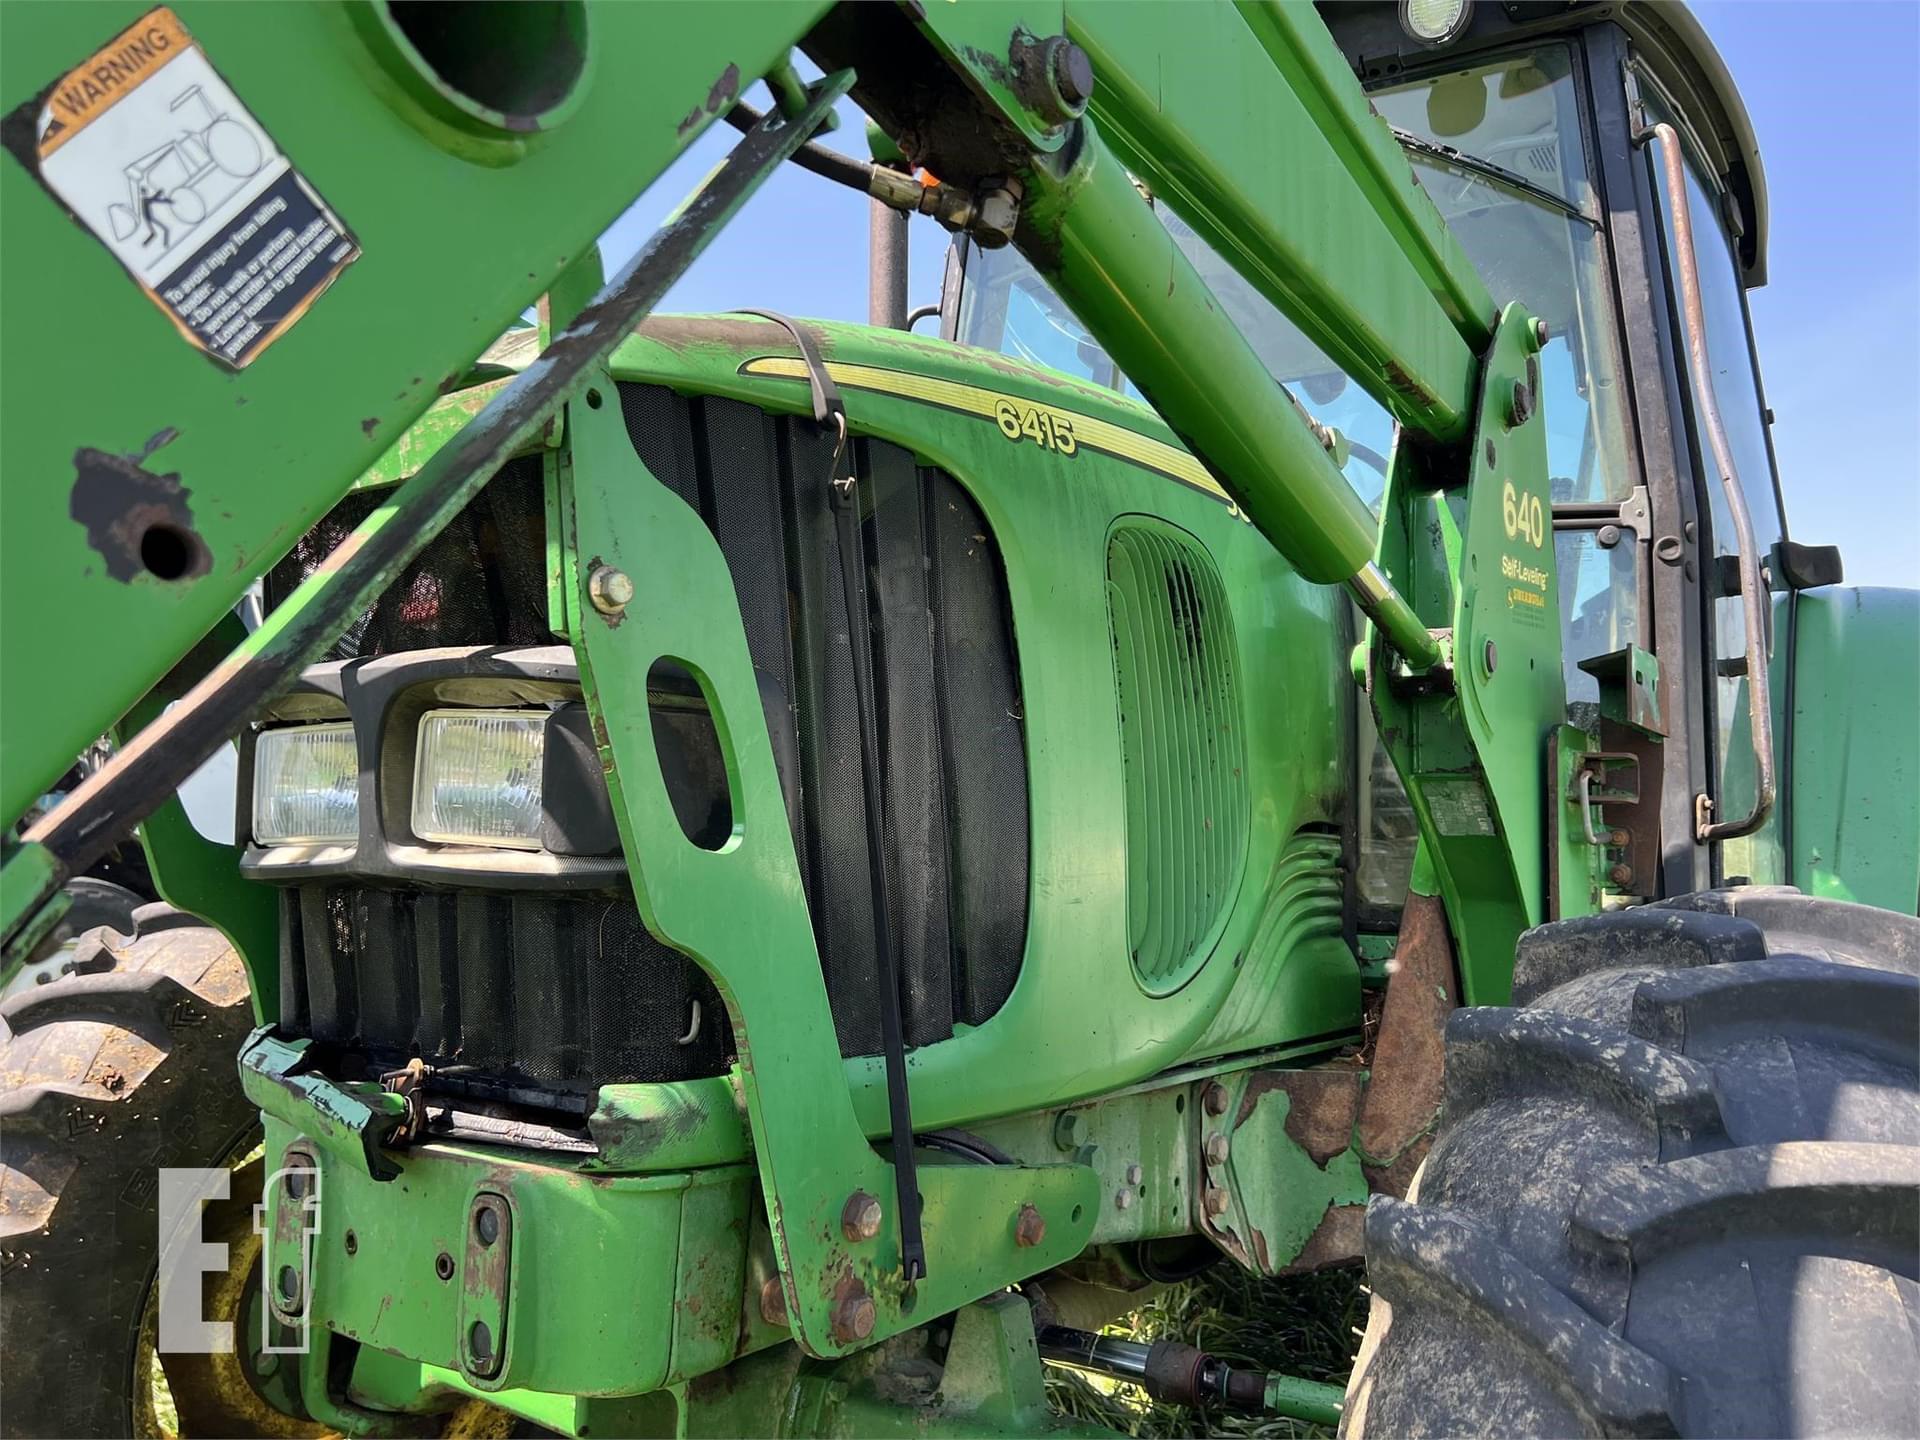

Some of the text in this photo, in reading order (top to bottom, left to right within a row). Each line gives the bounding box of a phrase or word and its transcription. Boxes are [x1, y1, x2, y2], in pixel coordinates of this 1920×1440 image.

[57, 28, 170, 116] WARNING
[166, 196, 287, 304] To avoid injury from falling
[197, 228, 296, 323] Do not walk or perform
[206, 301, 242, 335] service
[238, 277, 267, 305] under
[264, 268, 276, 281] a
[272, 242, 300, 273] raised
[216, 316, 247, 345] Lower
[243, 288, 276, 319] loader
[272, 278, 286, 294] to
[281, 250, 315, 286] ground
[312, 228, 338, 255] when
[996, 400, 1077, 457] 6415
[1503, 481, 1543, 549] 640
